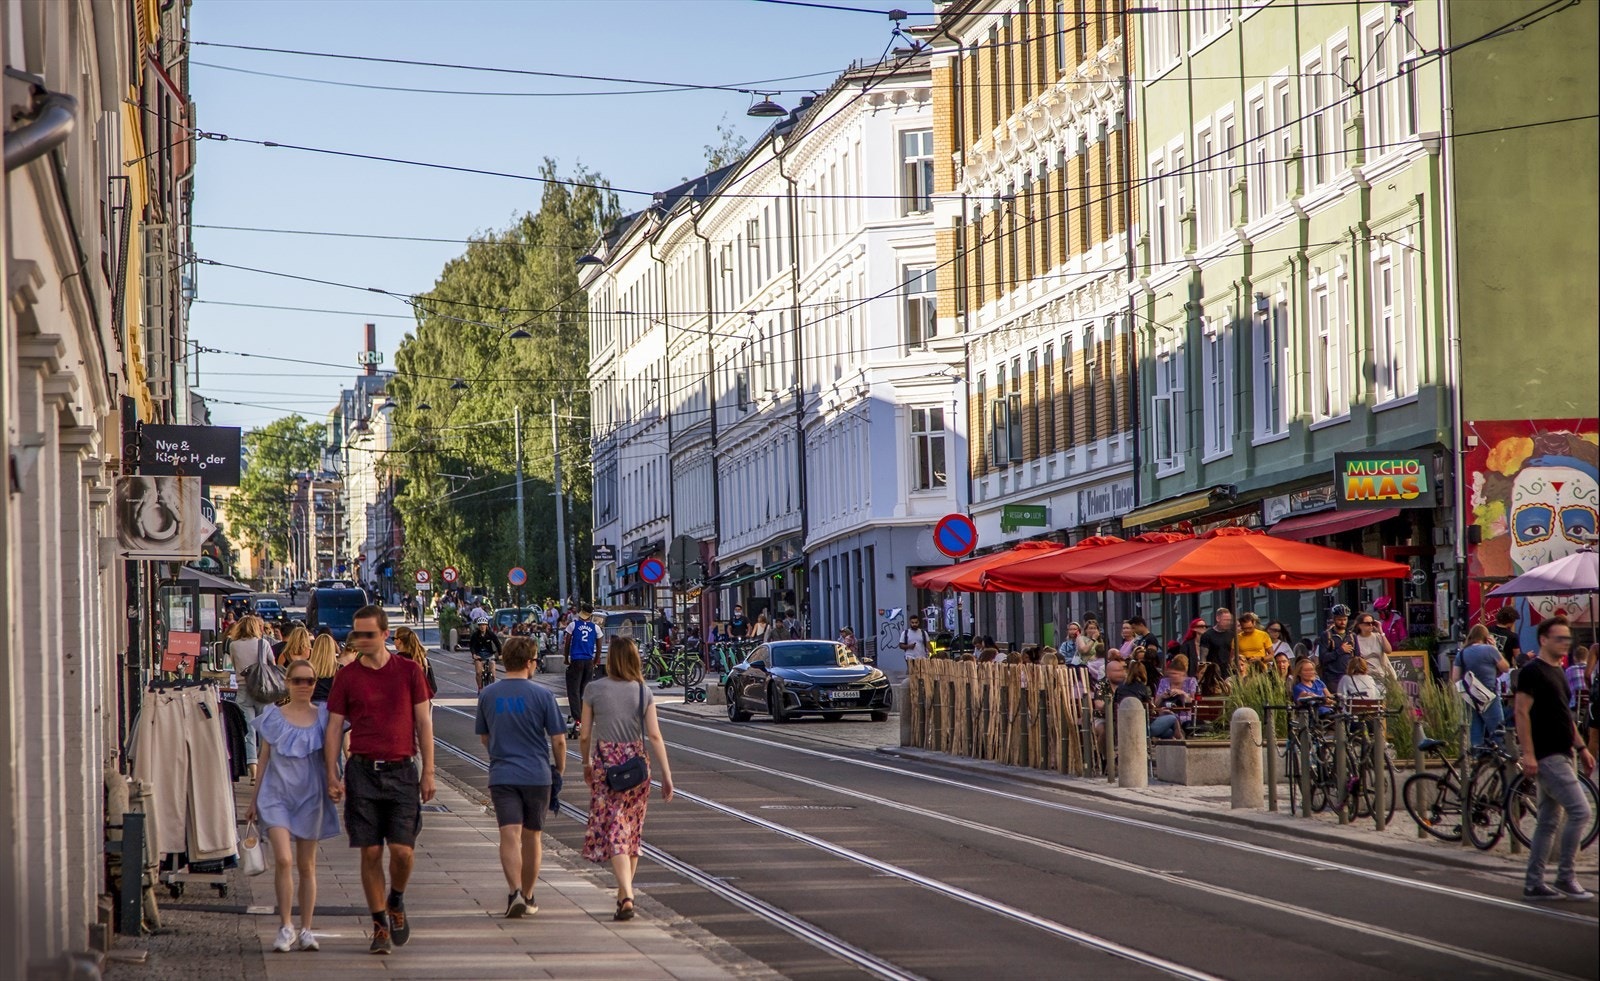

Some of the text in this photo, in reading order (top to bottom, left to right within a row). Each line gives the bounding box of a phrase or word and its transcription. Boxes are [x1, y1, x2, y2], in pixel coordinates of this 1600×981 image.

[156, 440, 190, 452] Nye &
[1348, 460, 1419, 476] MUCHO
[1346, 476, 1420, 500] MAS
[1087, 487, 1110, 516] Velouria
[581, 630, 589, 642] 2
[1390, 660, 1407, 671] Try
